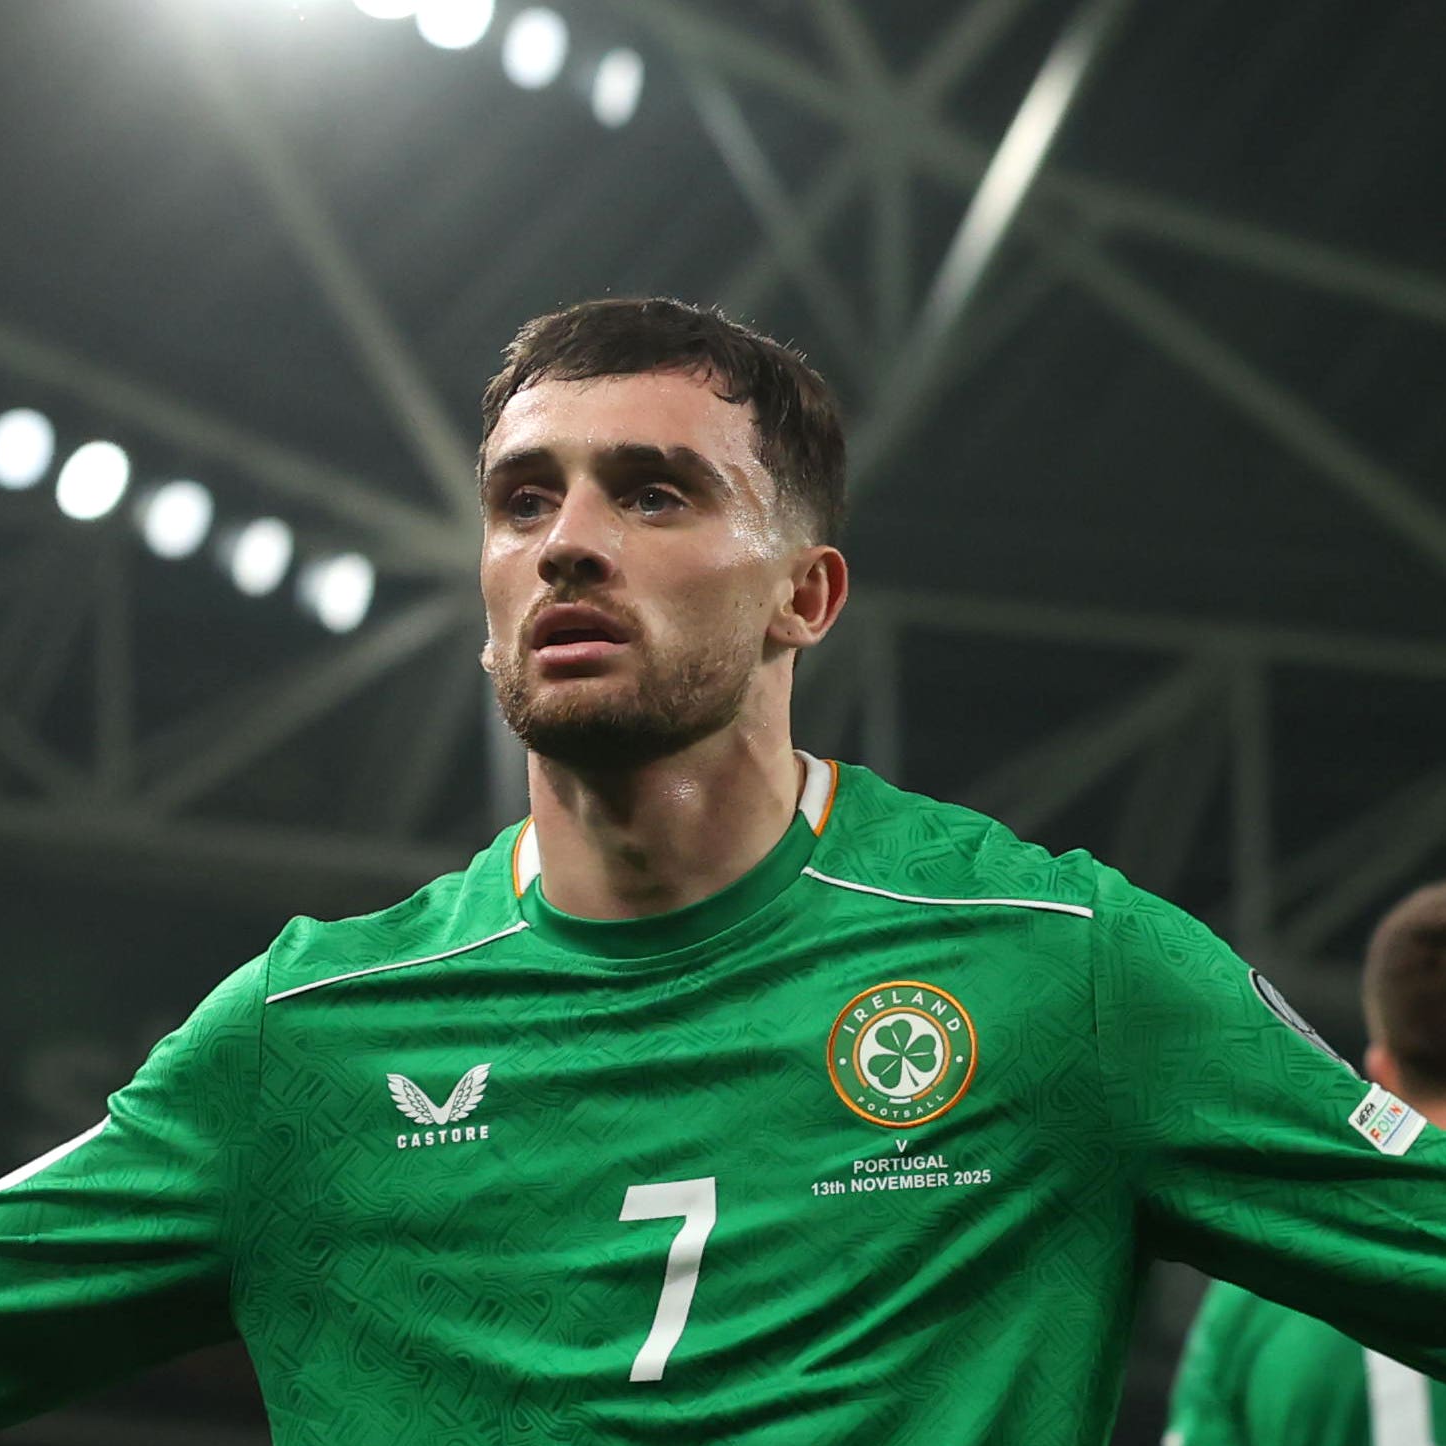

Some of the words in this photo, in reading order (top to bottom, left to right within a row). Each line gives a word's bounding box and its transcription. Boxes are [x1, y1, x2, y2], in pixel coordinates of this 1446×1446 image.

[843, 990, 961, 1035] IRELAND
[857, 1093, 944, 1118] FOOTBALL
[1355, 1102, 1376, 1127] UEFA
[396, 1125, 489, 1149] CASTORE
[895, 1139, 907, 1153] V
[854, 1155, 948, 1174] PORTUGAL
[811, 1181, 846, 1196] 13th
[850, 1173, 949, 1193] NOVEMBER
[954, 1169, 991, 1186] 2025
[618, 1176, 717, 1383] 7
